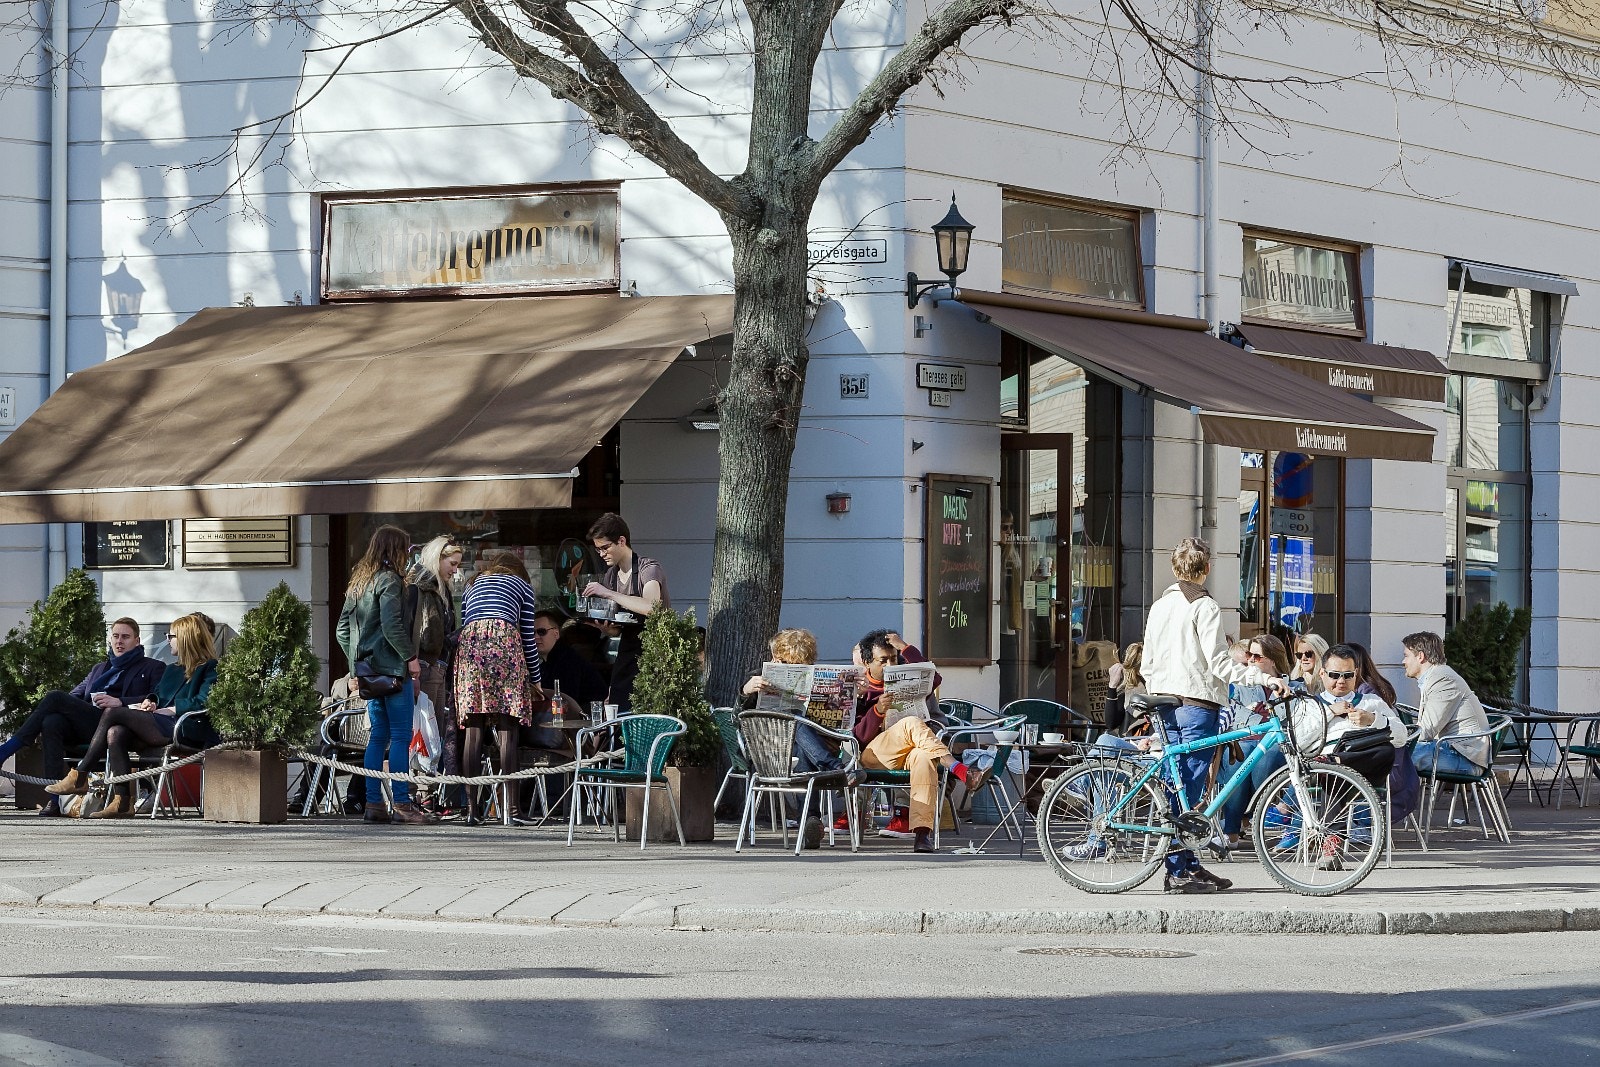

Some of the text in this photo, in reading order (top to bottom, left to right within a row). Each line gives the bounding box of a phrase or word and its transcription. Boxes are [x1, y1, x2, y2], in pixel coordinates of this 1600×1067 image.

[340, 211, 605, 275] Kaffebrenneriet
[1328, 367, 1375, 391] Kaffebrenneriet
[1295, 427, 1347, 452] Kaffebrenneriet
[943, 495, 968, 521] DAGENS
